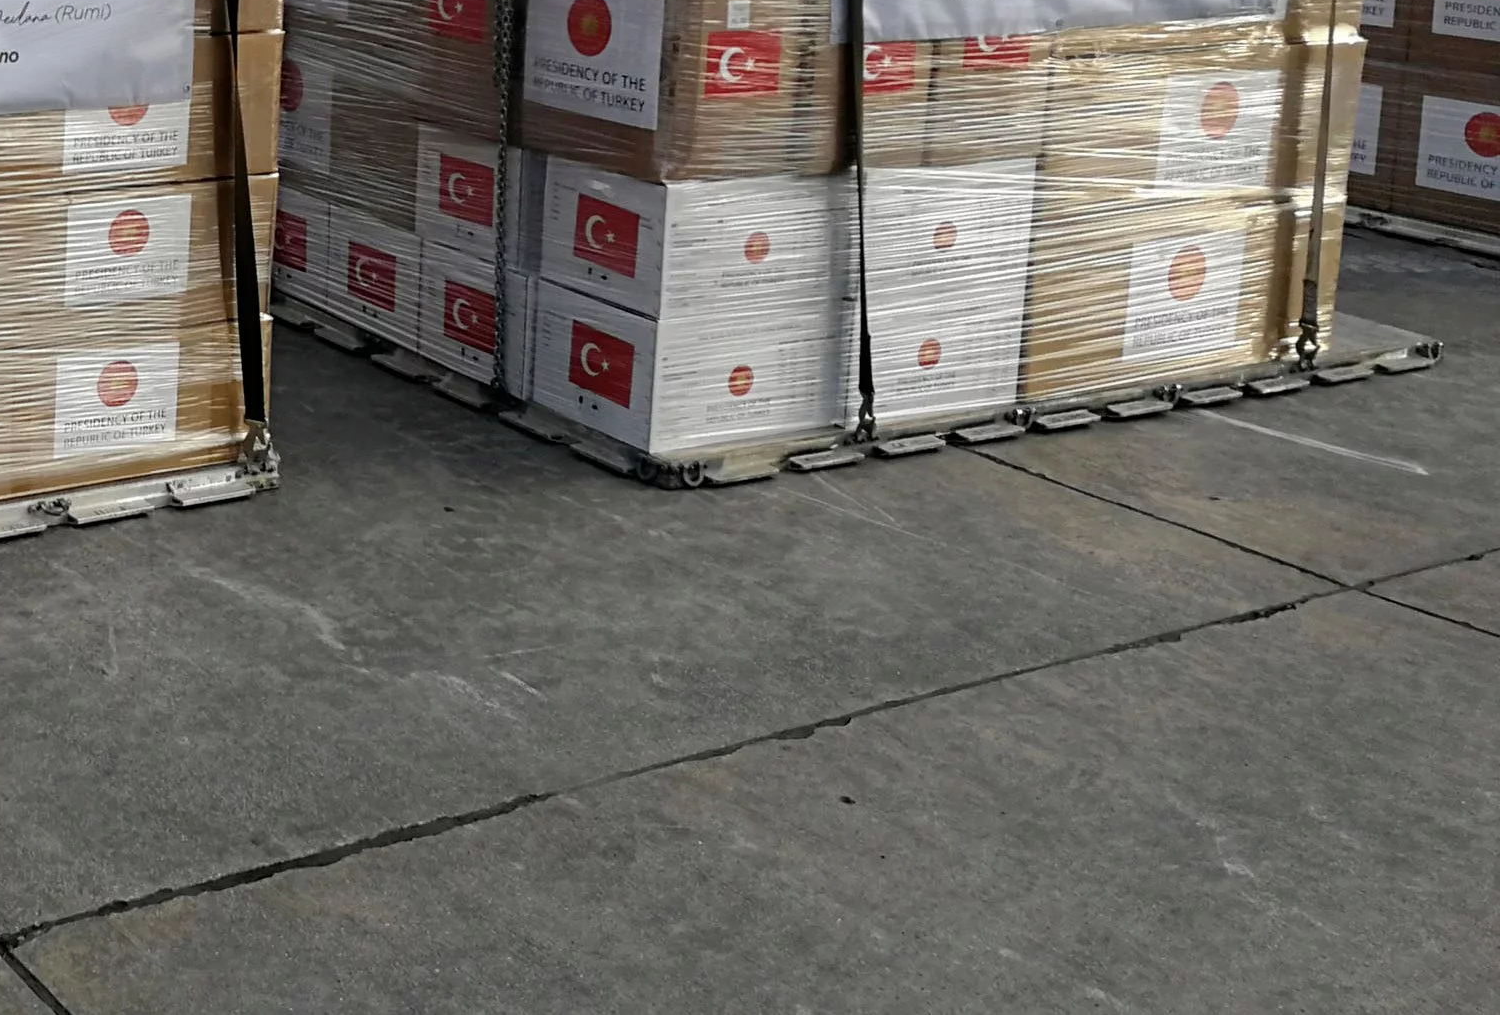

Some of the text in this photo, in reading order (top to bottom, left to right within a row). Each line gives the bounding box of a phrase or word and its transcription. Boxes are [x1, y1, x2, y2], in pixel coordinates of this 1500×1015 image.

[55, 3, 112, 24] (Rumi)
[1445, 1, 1500, 17] PRESIDEN
[1443, 15, 1497, 31] REPUBLIC
[602, 71, 618, 86] OF
[621, 75, 647, 92] THE
[583, 87, 599, 102] OF
[601, 91, 645, 112] TURKEY
[159, 130, 179, 142] THE
[140, 146, 178, 159] TURKEY
[1428, 154, 1499, 176] PRESIDENCY
[1427, 168, 1496, 189] REPUBLIC OF
[159, 259, 179, 271] THE
[64, 416, 127, 433] PRESIDENCY
[129, 423, 166, 438] TURKEY
